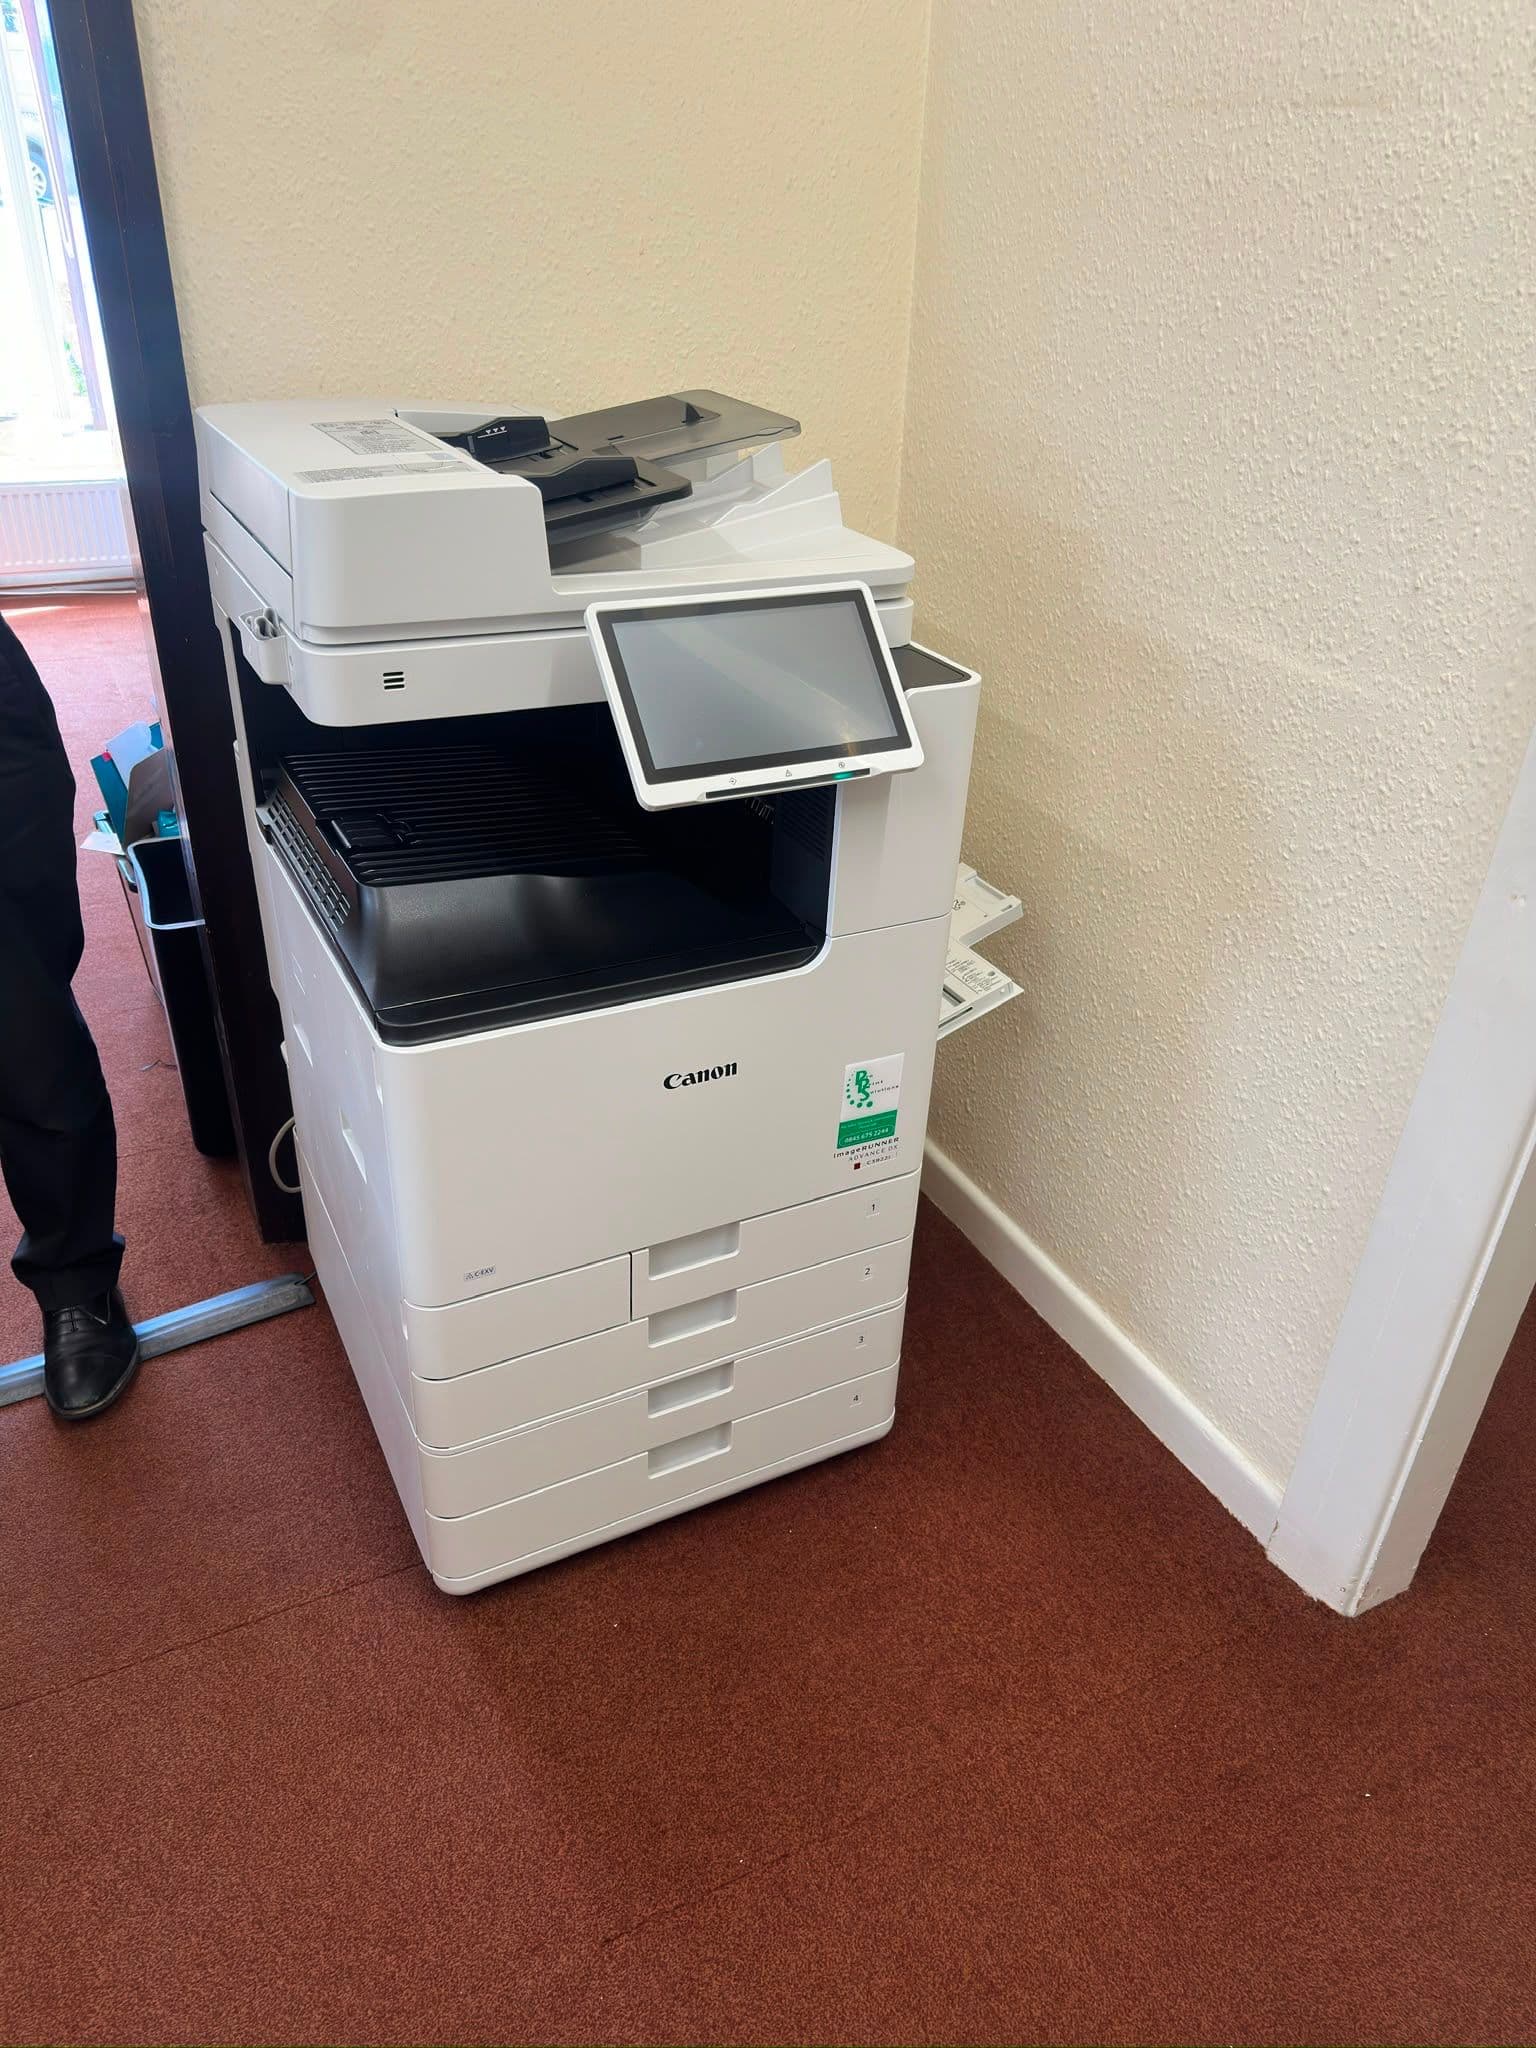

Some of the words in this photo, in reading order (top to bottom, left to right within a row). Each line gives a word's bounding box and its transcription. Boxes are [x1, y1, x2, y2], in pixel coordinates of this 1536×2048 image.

[663, 1062, 738, 1089] Canon
[833, 1136, 900, 1159] imageRUNNER
[849, 1147, 886, 1161] ADVANCE
[864, 1267, 871, 1275] 2
